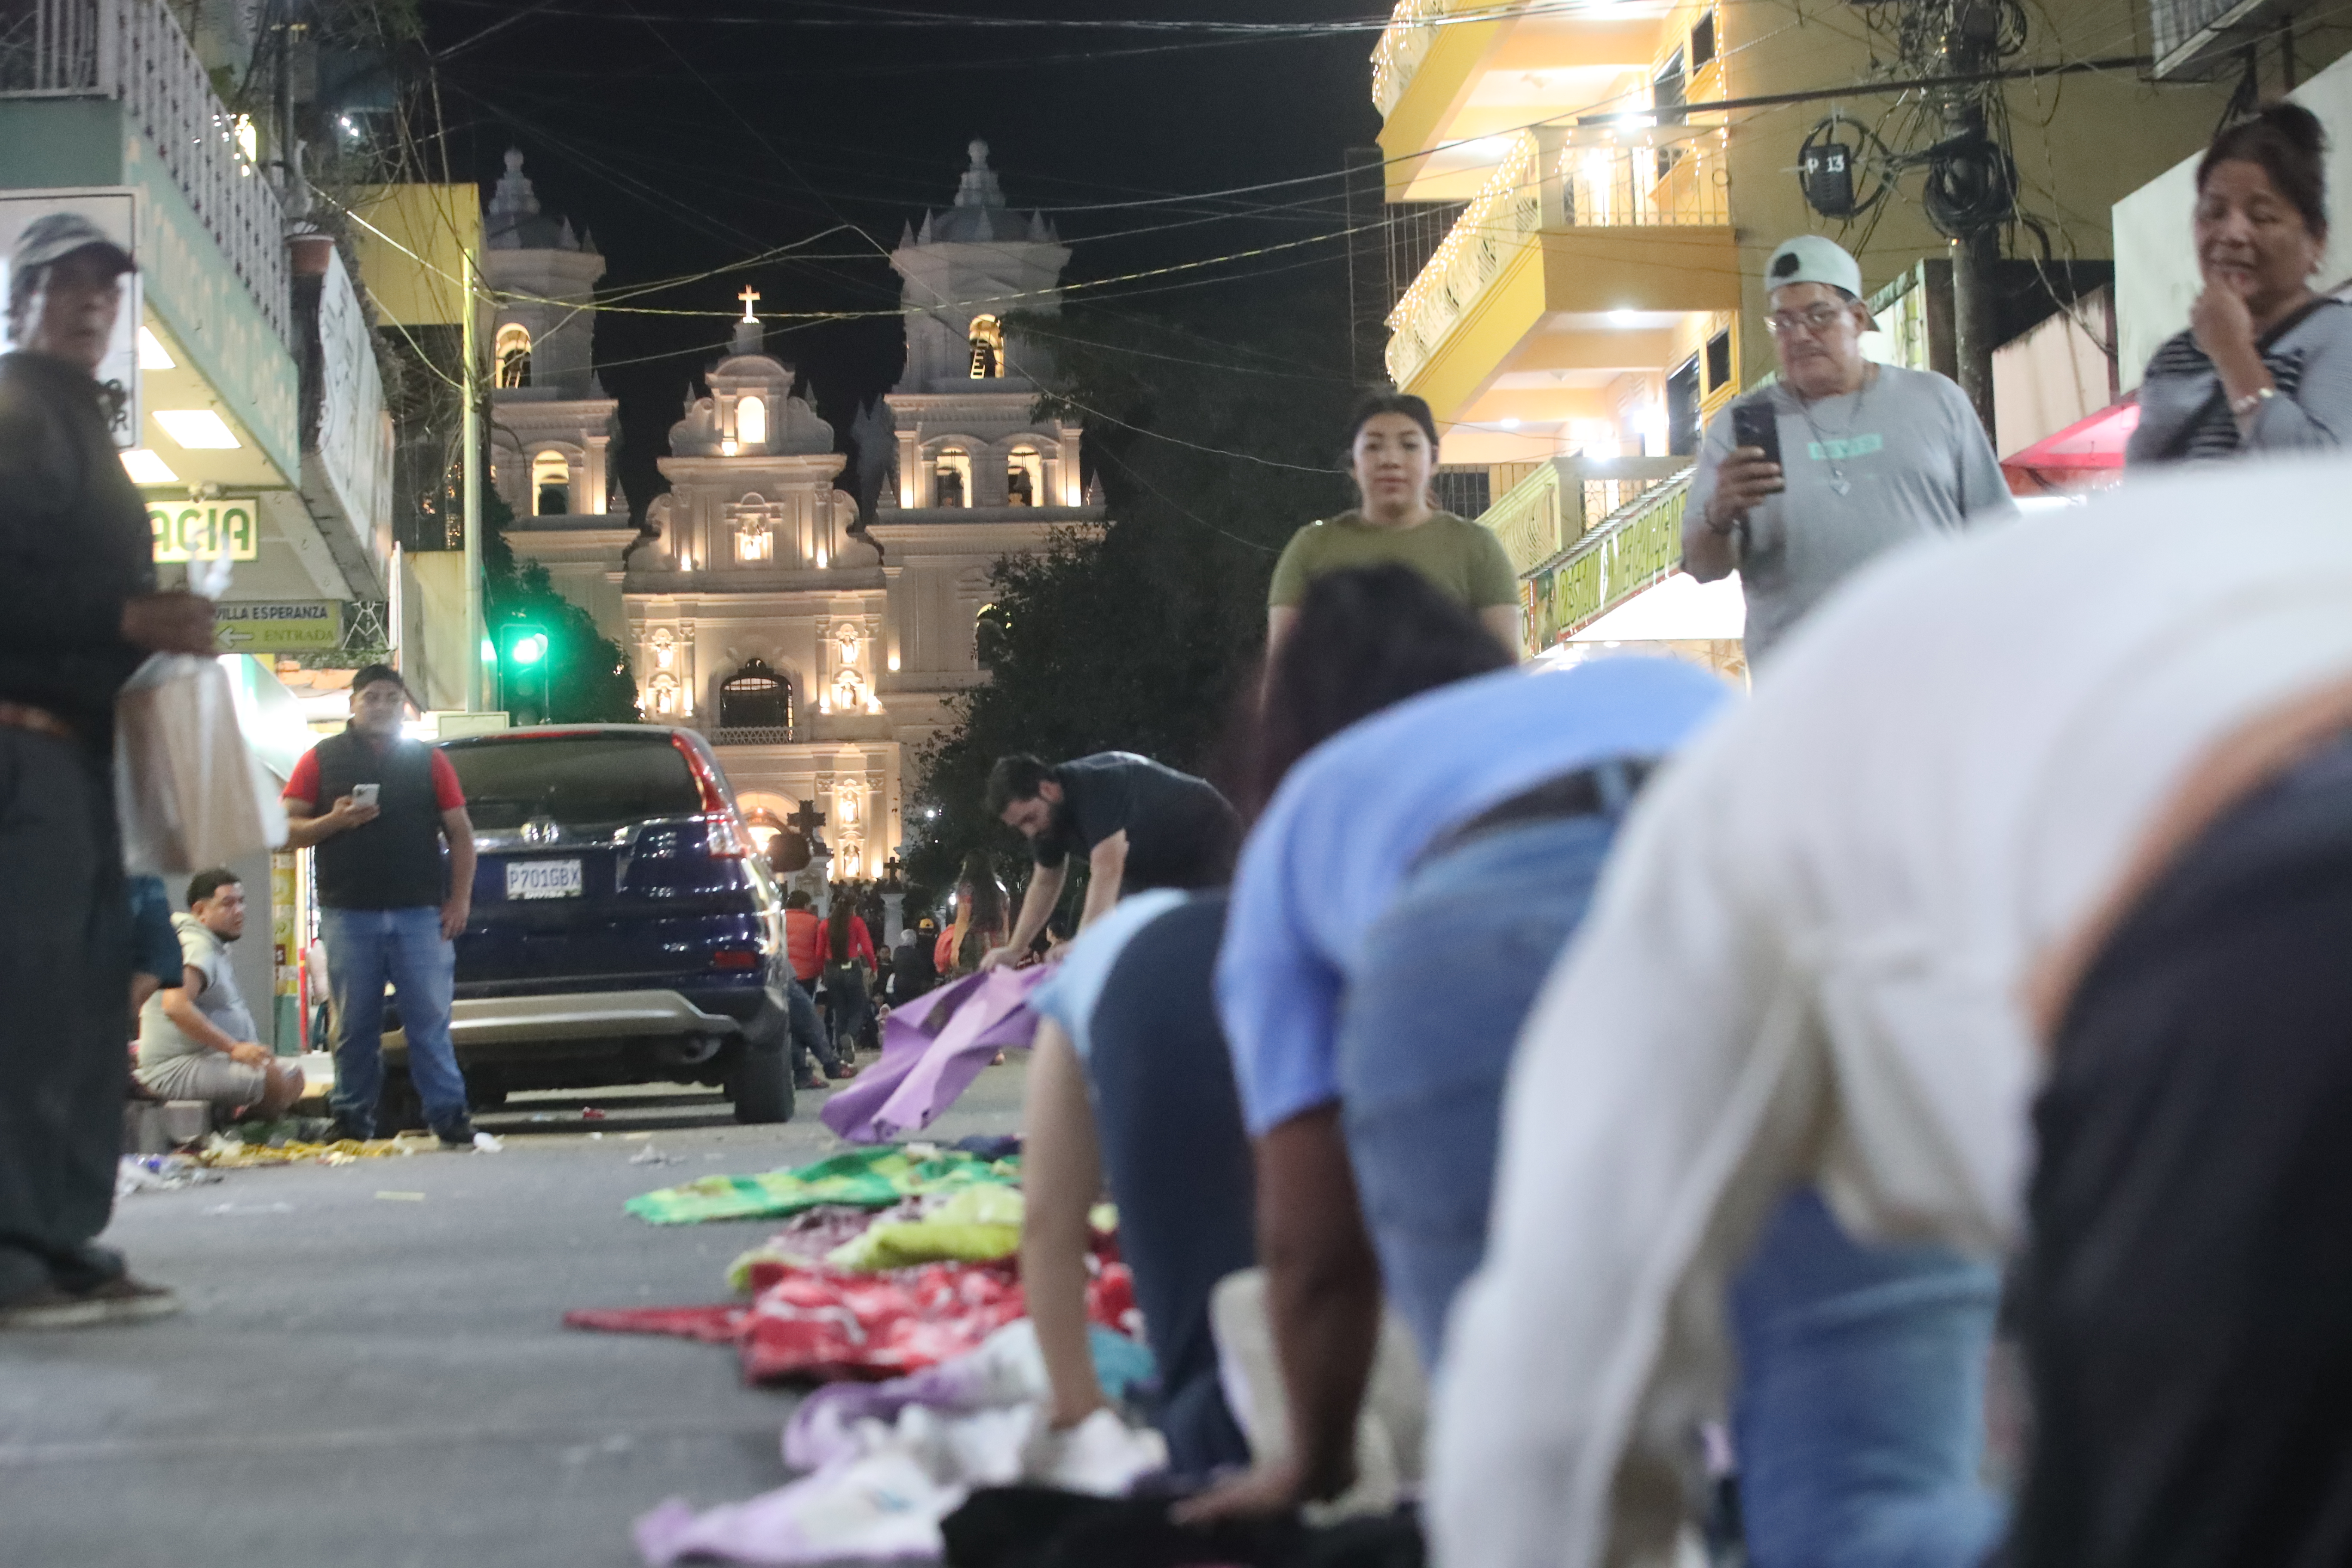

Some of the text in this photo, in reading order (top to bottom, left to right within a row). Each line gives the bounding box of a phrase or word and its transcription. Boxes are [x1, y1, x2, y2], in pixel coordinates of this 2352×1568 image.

[1808, 155, 1844, 174] P 13
[1558, 525, 1633, 629] RESTAUANTE
[253, 606, 328, 619] ESPERANZA
[264, 629, 334, 641] ENTRADA
[510, 867, 580, 888] P701GBX
